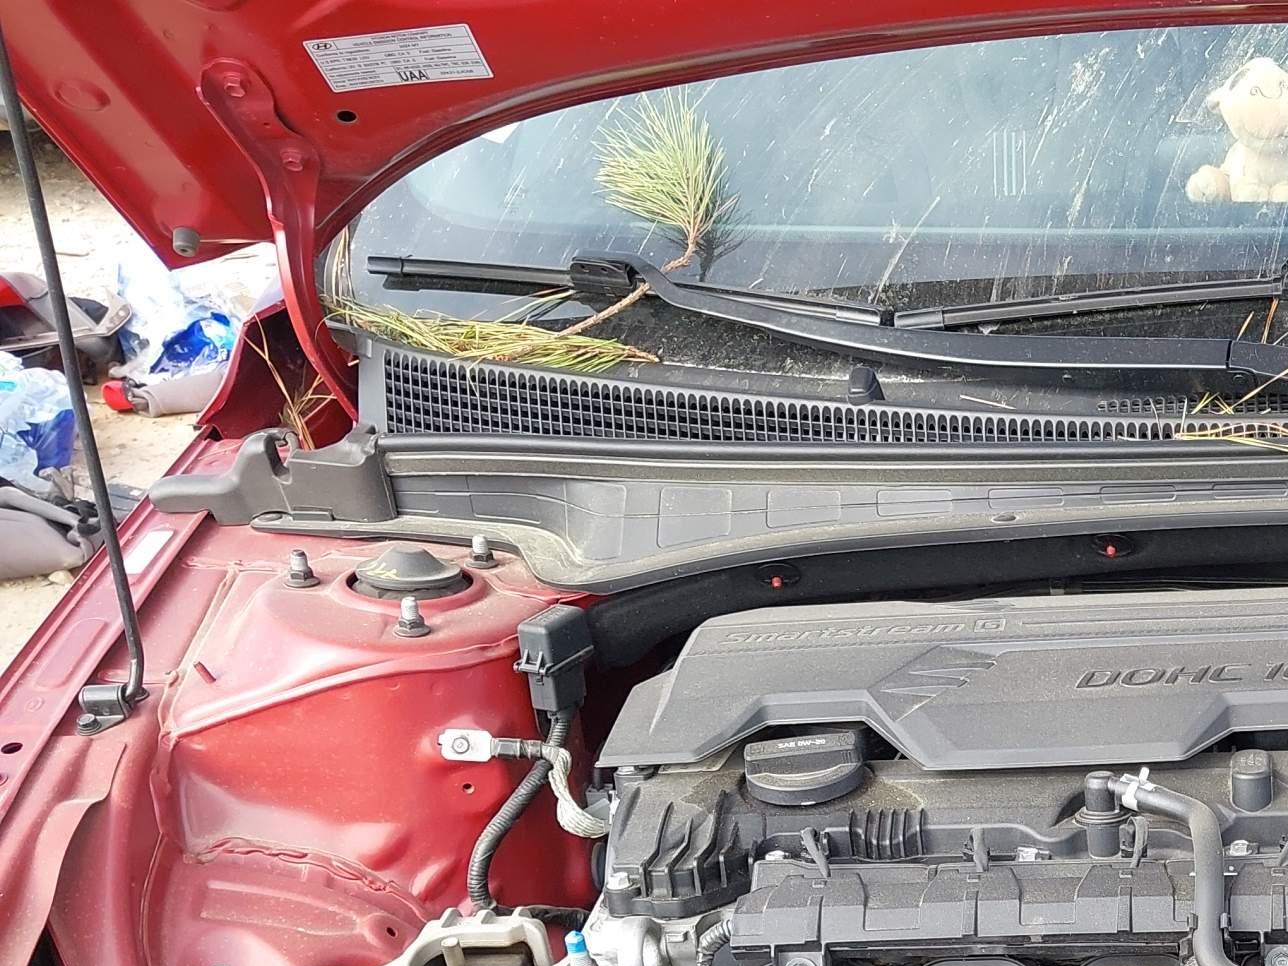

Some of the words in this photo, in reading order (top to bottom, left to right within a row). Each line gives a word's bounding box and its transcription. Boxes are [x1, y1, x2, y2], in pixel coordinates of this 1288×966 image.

[399, 69, 429, 81] UAA
[1076, 663, 1252, 689] DOHC
[777, 741, 796, 749] SAE
